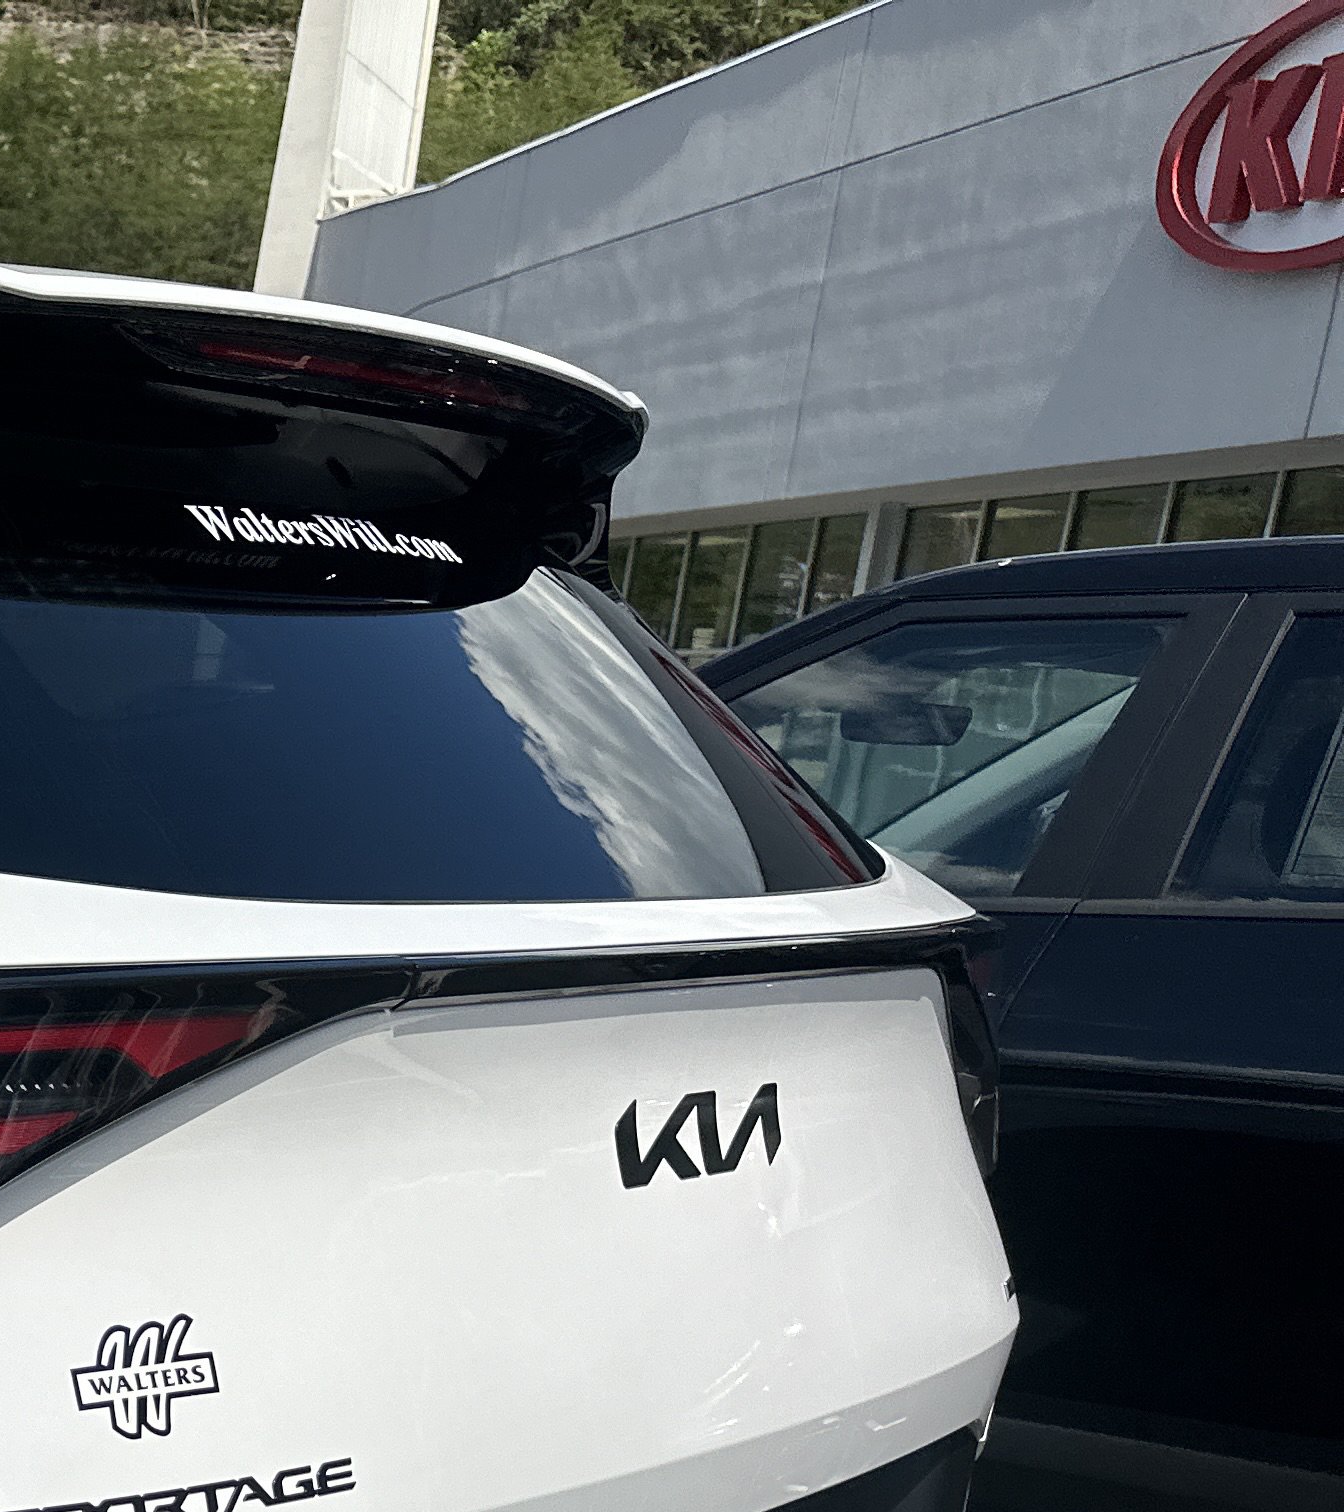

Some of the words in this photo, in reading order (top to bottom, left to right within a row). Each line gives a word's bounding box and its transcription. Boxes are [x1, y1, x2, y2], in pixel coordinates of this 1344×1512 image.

[1207, 52, 1344, 224] KI
[183, 504, 463, 563] WaltersWill.com
[614, 1082, 782, 1189] KIA
[87, 1364, 206, 1395] WALTERS
